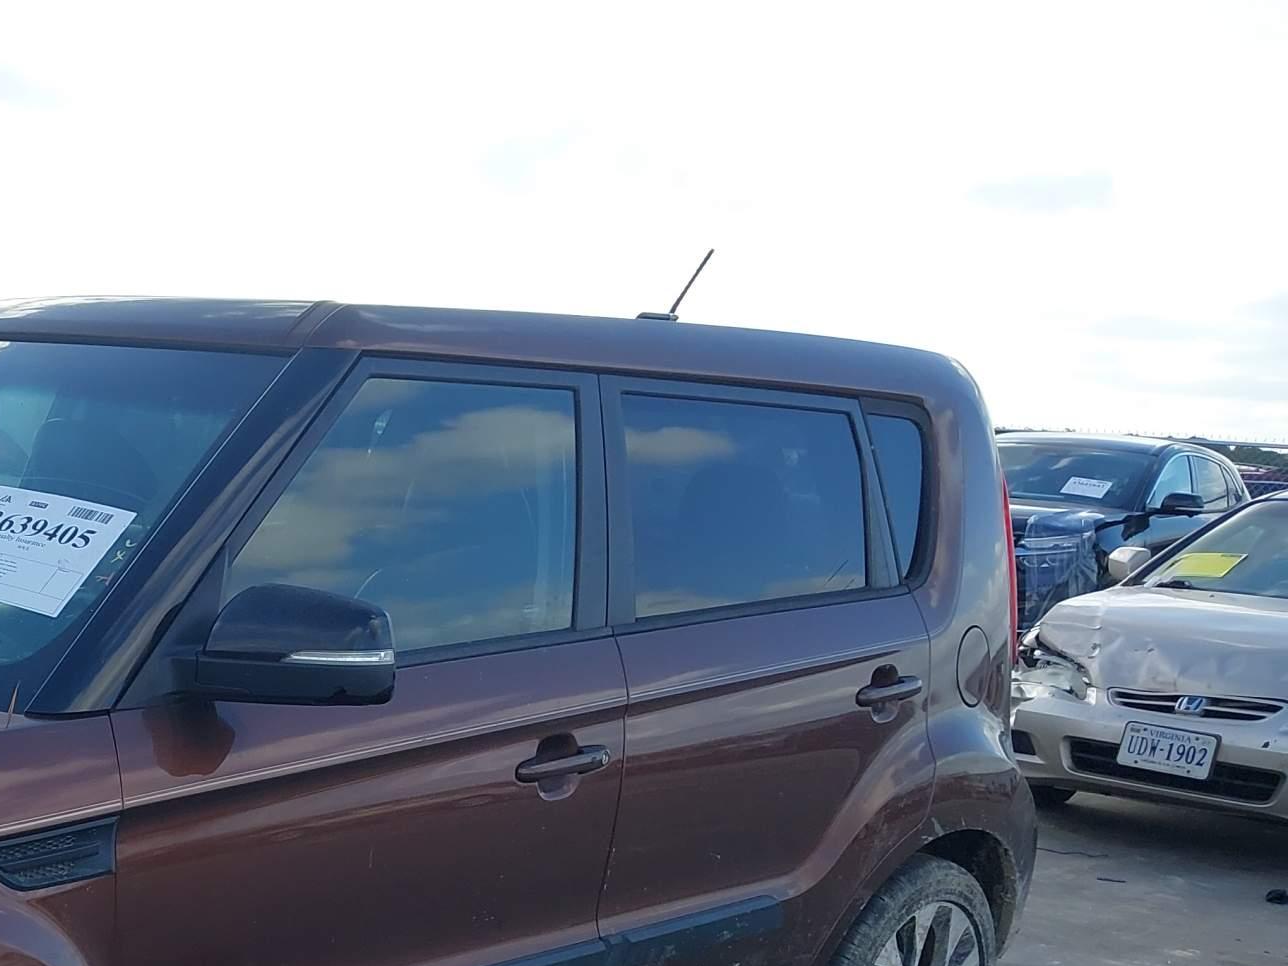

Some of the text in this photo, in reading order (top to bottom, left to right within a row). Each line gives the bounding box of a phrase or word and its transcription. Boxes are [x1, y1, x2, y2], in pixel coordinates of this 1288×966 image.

[15, 536, 47, 548] Insurance
[1149, 729, 1192, 744] VIRGINIA
[1127, 735, 1208, 767] UDW-1902
